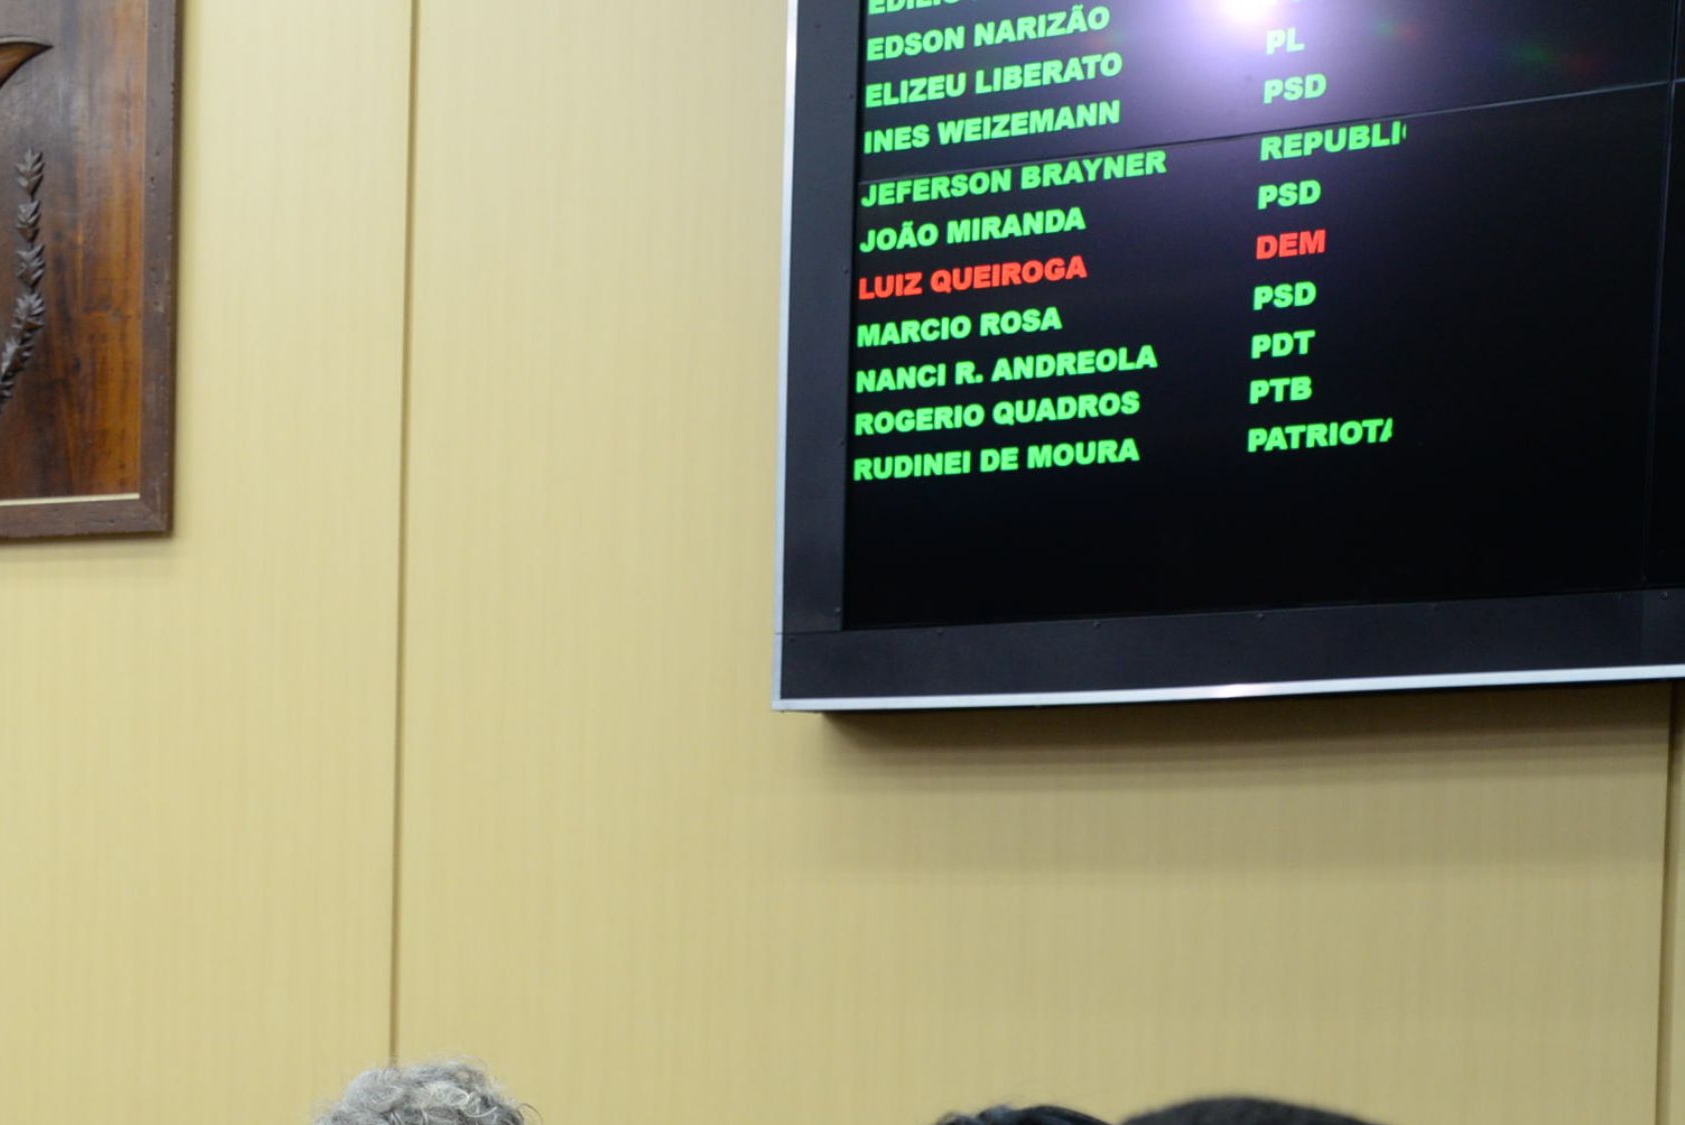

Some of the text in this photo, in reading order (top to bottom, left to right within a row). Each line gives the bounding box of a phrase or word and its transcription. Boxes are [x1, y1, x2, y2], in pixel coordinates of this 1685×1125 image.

[866, 4, 1110, 61] EDSON NARIZÃO
[1266, 27, 1305, 55] PL
[865, 52, 1123, 108] ELIZEU LIBERATO
[1263, 73, 1327, 104] PSD
[863, 100, 1120, 154] INES WEIZEMANN
[1260, 120, 1407, 161] REPUBLI
[860, 150, 1167, 208] JEFERSON BRAYNER
[1257, 179, 1322, 210] PSD
[859, 206, 1086, 252] JOÃO MIRANDA
[1255, 229, 1326, 260] DEM
[858, 255, 1088, 300] LUIZ QUEIROGA
[1253, 281, 1318, 311] PSD
[857, 306, 1063, 348] MARCIO ROSA
[1251, 329, 1316, 359] PDT
[856, 344, 1159, 393] NANCI R. ANDREOLA
[1249, 376, 1313, 404] PTB
[854, 390, 1141, 436] ROGERIO QUADROS
[853, 437, 1140, 481] RUDINEI DE MOURA
